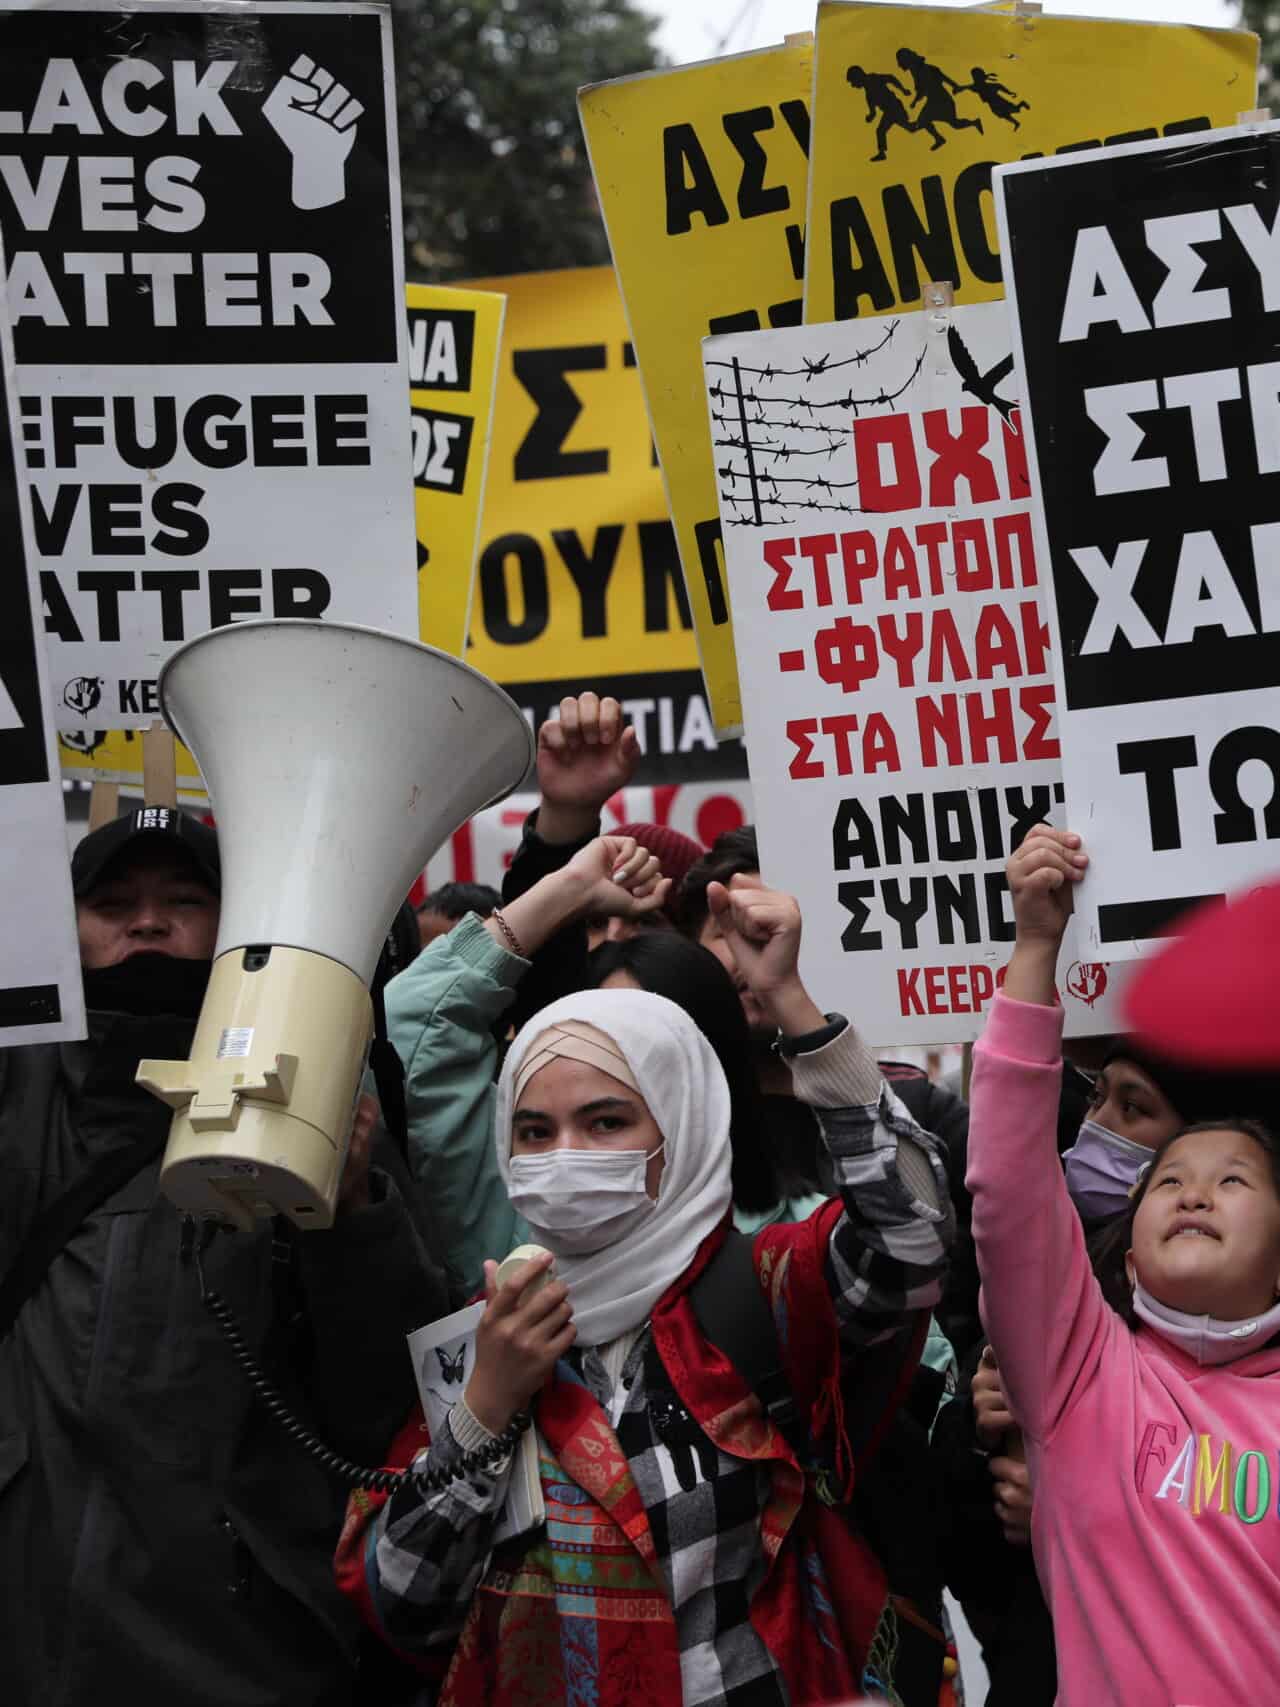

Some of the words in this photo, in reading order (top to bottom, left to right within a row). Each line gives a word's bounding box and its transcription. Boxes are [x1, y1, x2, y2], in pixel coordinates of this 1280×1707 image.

[6, 252, 335, 326] ATTER
[853, 405, 1032, 513] ΟΧΙ
[763, 512, 1038, 611] ΣΤΡΑΤΟΠ
[786, 712, 901, 780] ΣΤΑ
[915, 684, 1061, 767] ΝΗΣ
[832, 783, 1064, 871] ΑΝΟΙΧ
